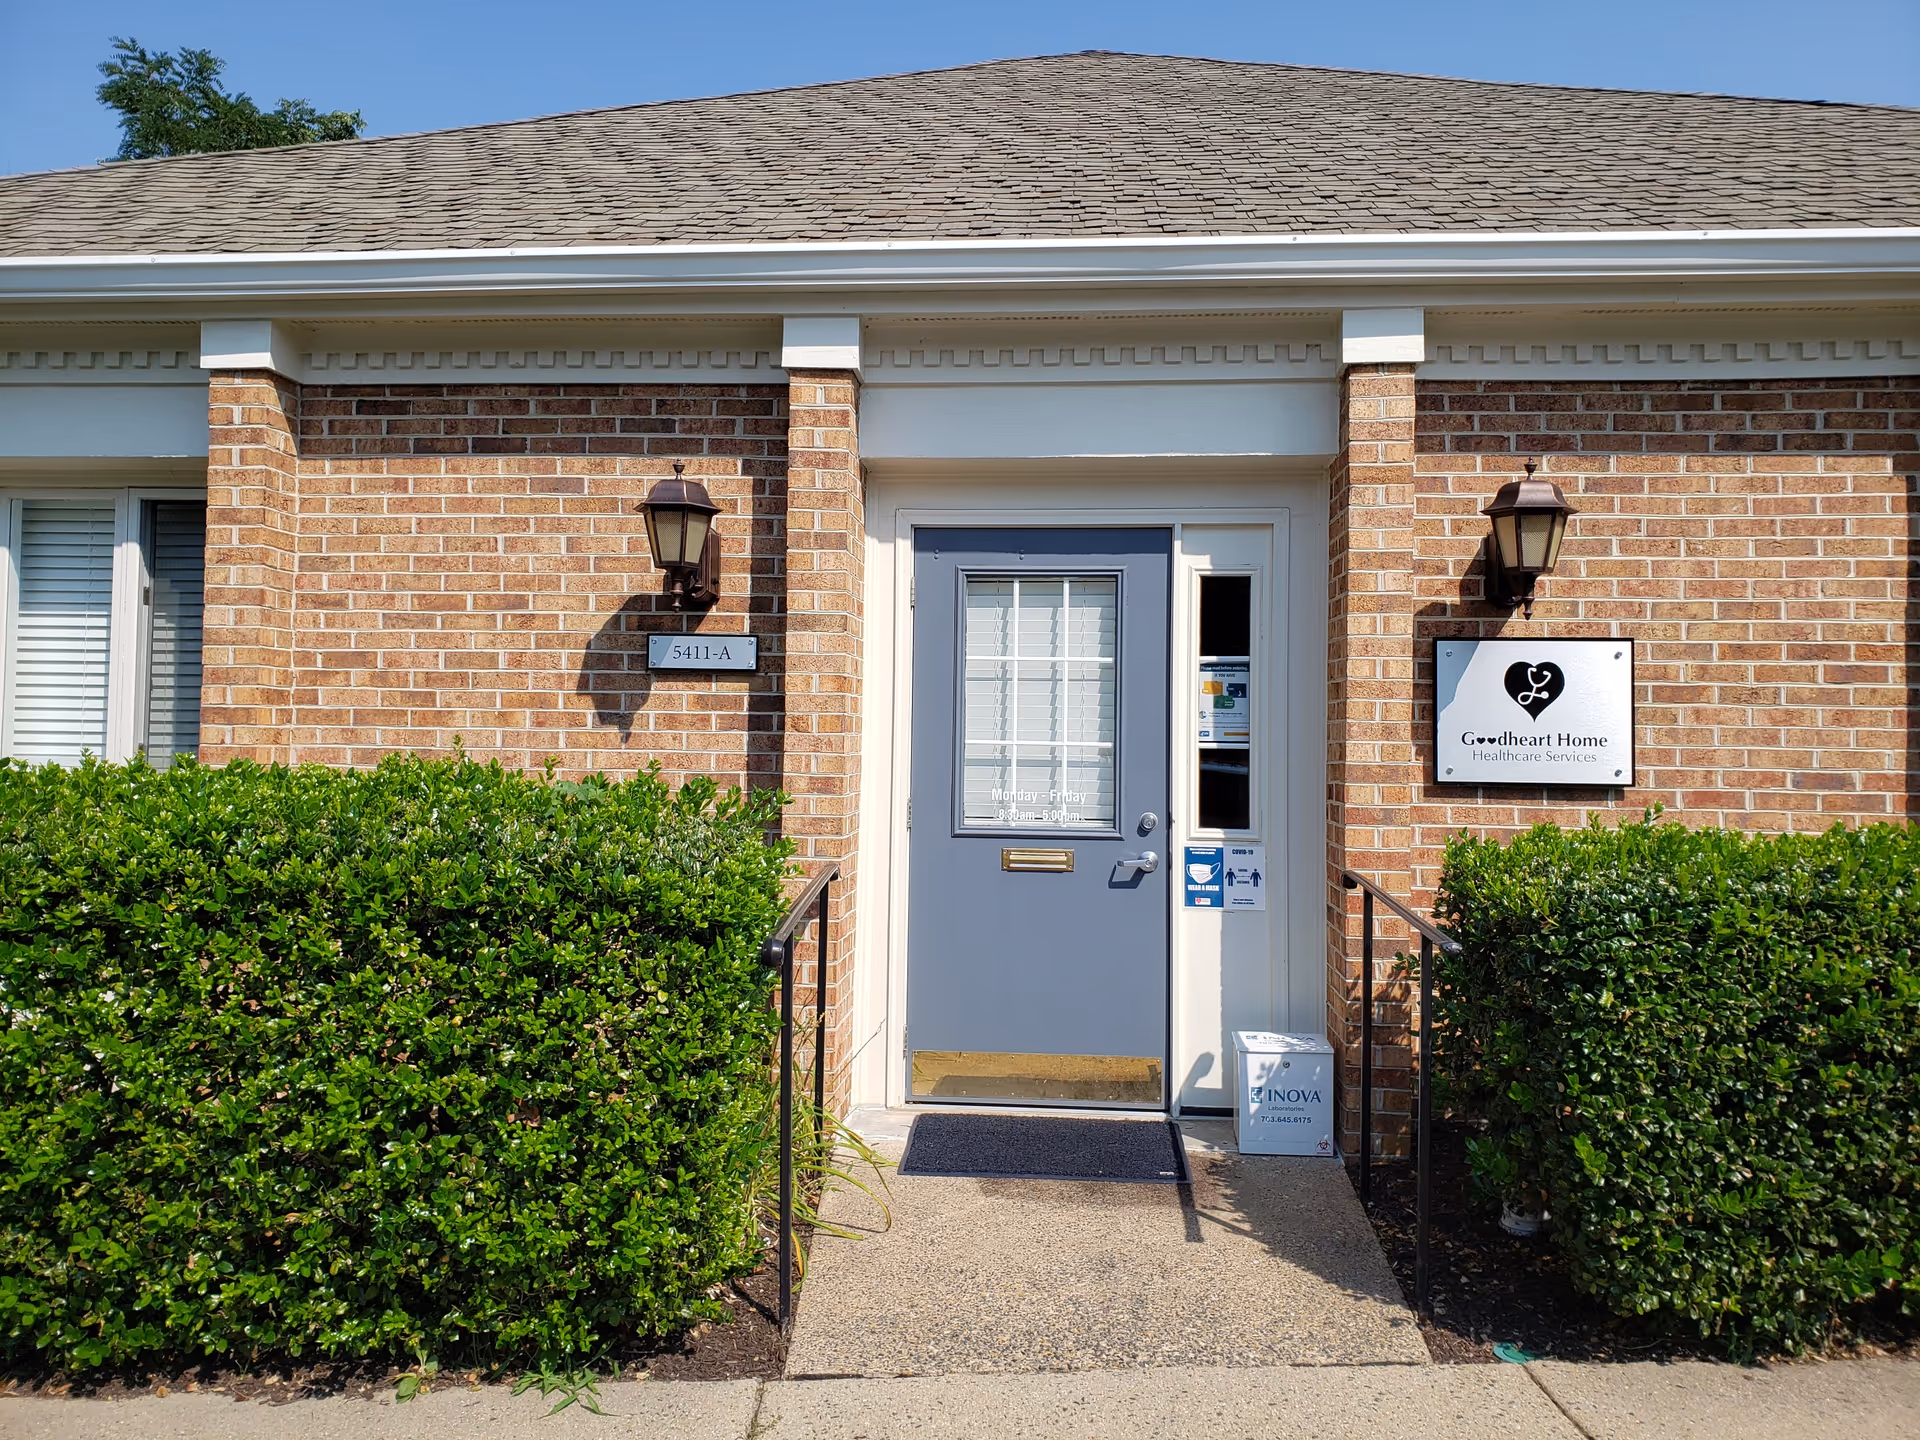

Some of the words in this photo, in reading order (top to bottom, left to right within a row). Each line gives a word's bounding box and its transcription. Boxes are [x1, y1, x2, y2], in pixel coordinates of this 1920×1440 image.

[673, 645, 732, 660] 5411-A
[1557, 733, 1608, 747] Home
[1472, 749, 1542, 762] Healthcare
[1545, 751, 1597, 763] Services
[991, 788, 1038, 803] Monday
[1050, 789, 1086, 804] Friday
[999, 809, 1035, 820] 8:30am
[1042, 809, 1079, 823] 5:00pm
[1268, 1089, 1321, 1103] INOVA
